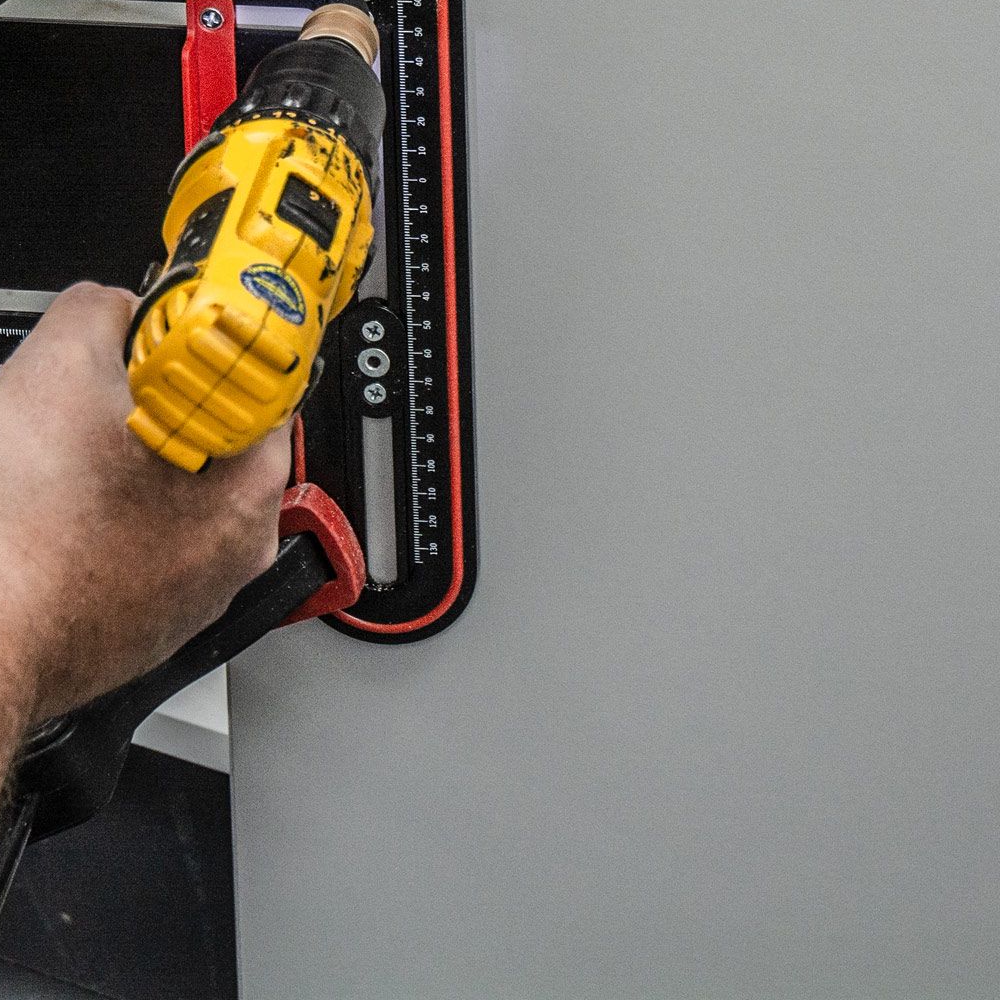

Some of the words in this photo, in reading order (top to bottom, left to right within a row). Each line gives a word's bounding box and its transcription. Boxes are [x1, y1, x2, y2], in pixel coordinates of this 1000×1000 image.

[415, 27, 422, 37] 50
[415, 57, 423, 66] 40
[416, 87, 424, 96] 30
[417, 117, 425, 126] 20
[418, 146, 426, 155] 10
[420, 205, 428, 213] 10
[421, 234, 429, 243] 20
[422, 263, 430, 272] 30
[422, 292, 430, 301] 40
[423, 321, 431, 330] 50
[424, 349, 432, 358] 60
[425, 377, 432, 386] 70
[426, 406, 433, 414] 80
[426, 434, 434, 442] 90
[428, 488, 436, 500] 110
